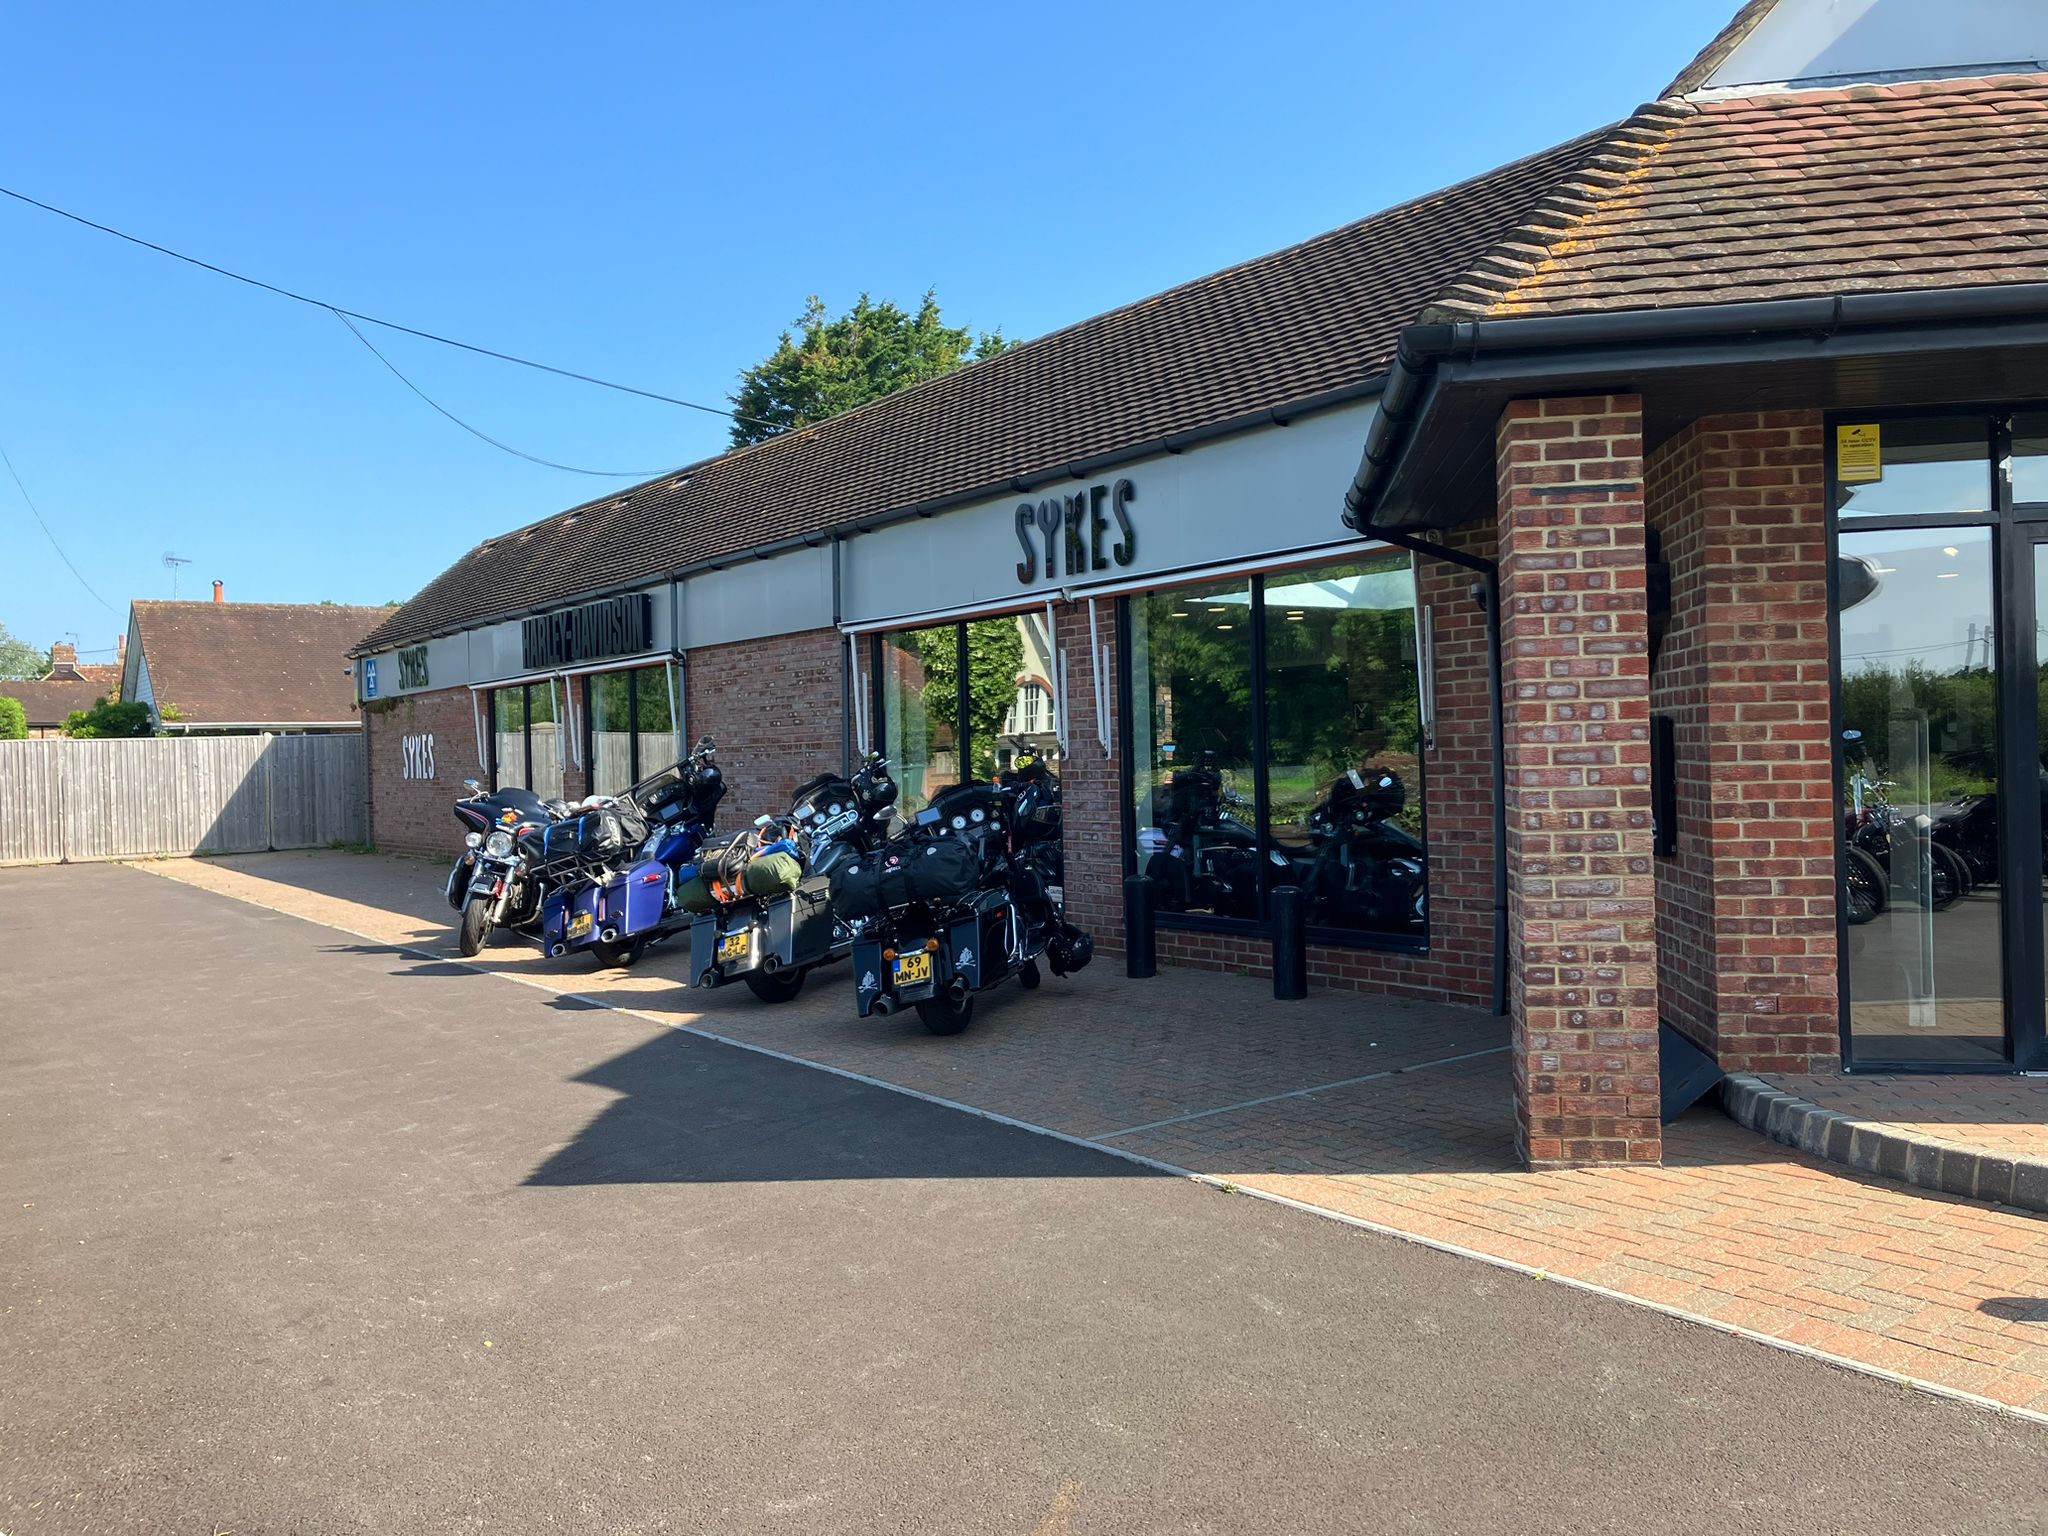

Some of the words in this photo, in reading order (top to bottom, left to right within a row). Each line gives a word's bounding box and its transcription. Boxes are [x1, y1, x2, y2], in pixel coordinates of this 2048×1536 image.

[1015, 479, 1134, 584] SYKES
[522, 593, 648, 669] HARLEY-DAVIDSON
[398, 645, 429, 690] SYKES
[403, 733, 435, 780] SYKES
[895, 966, 928, 982] MN-JV
[907, 957, 921, 968] 69
